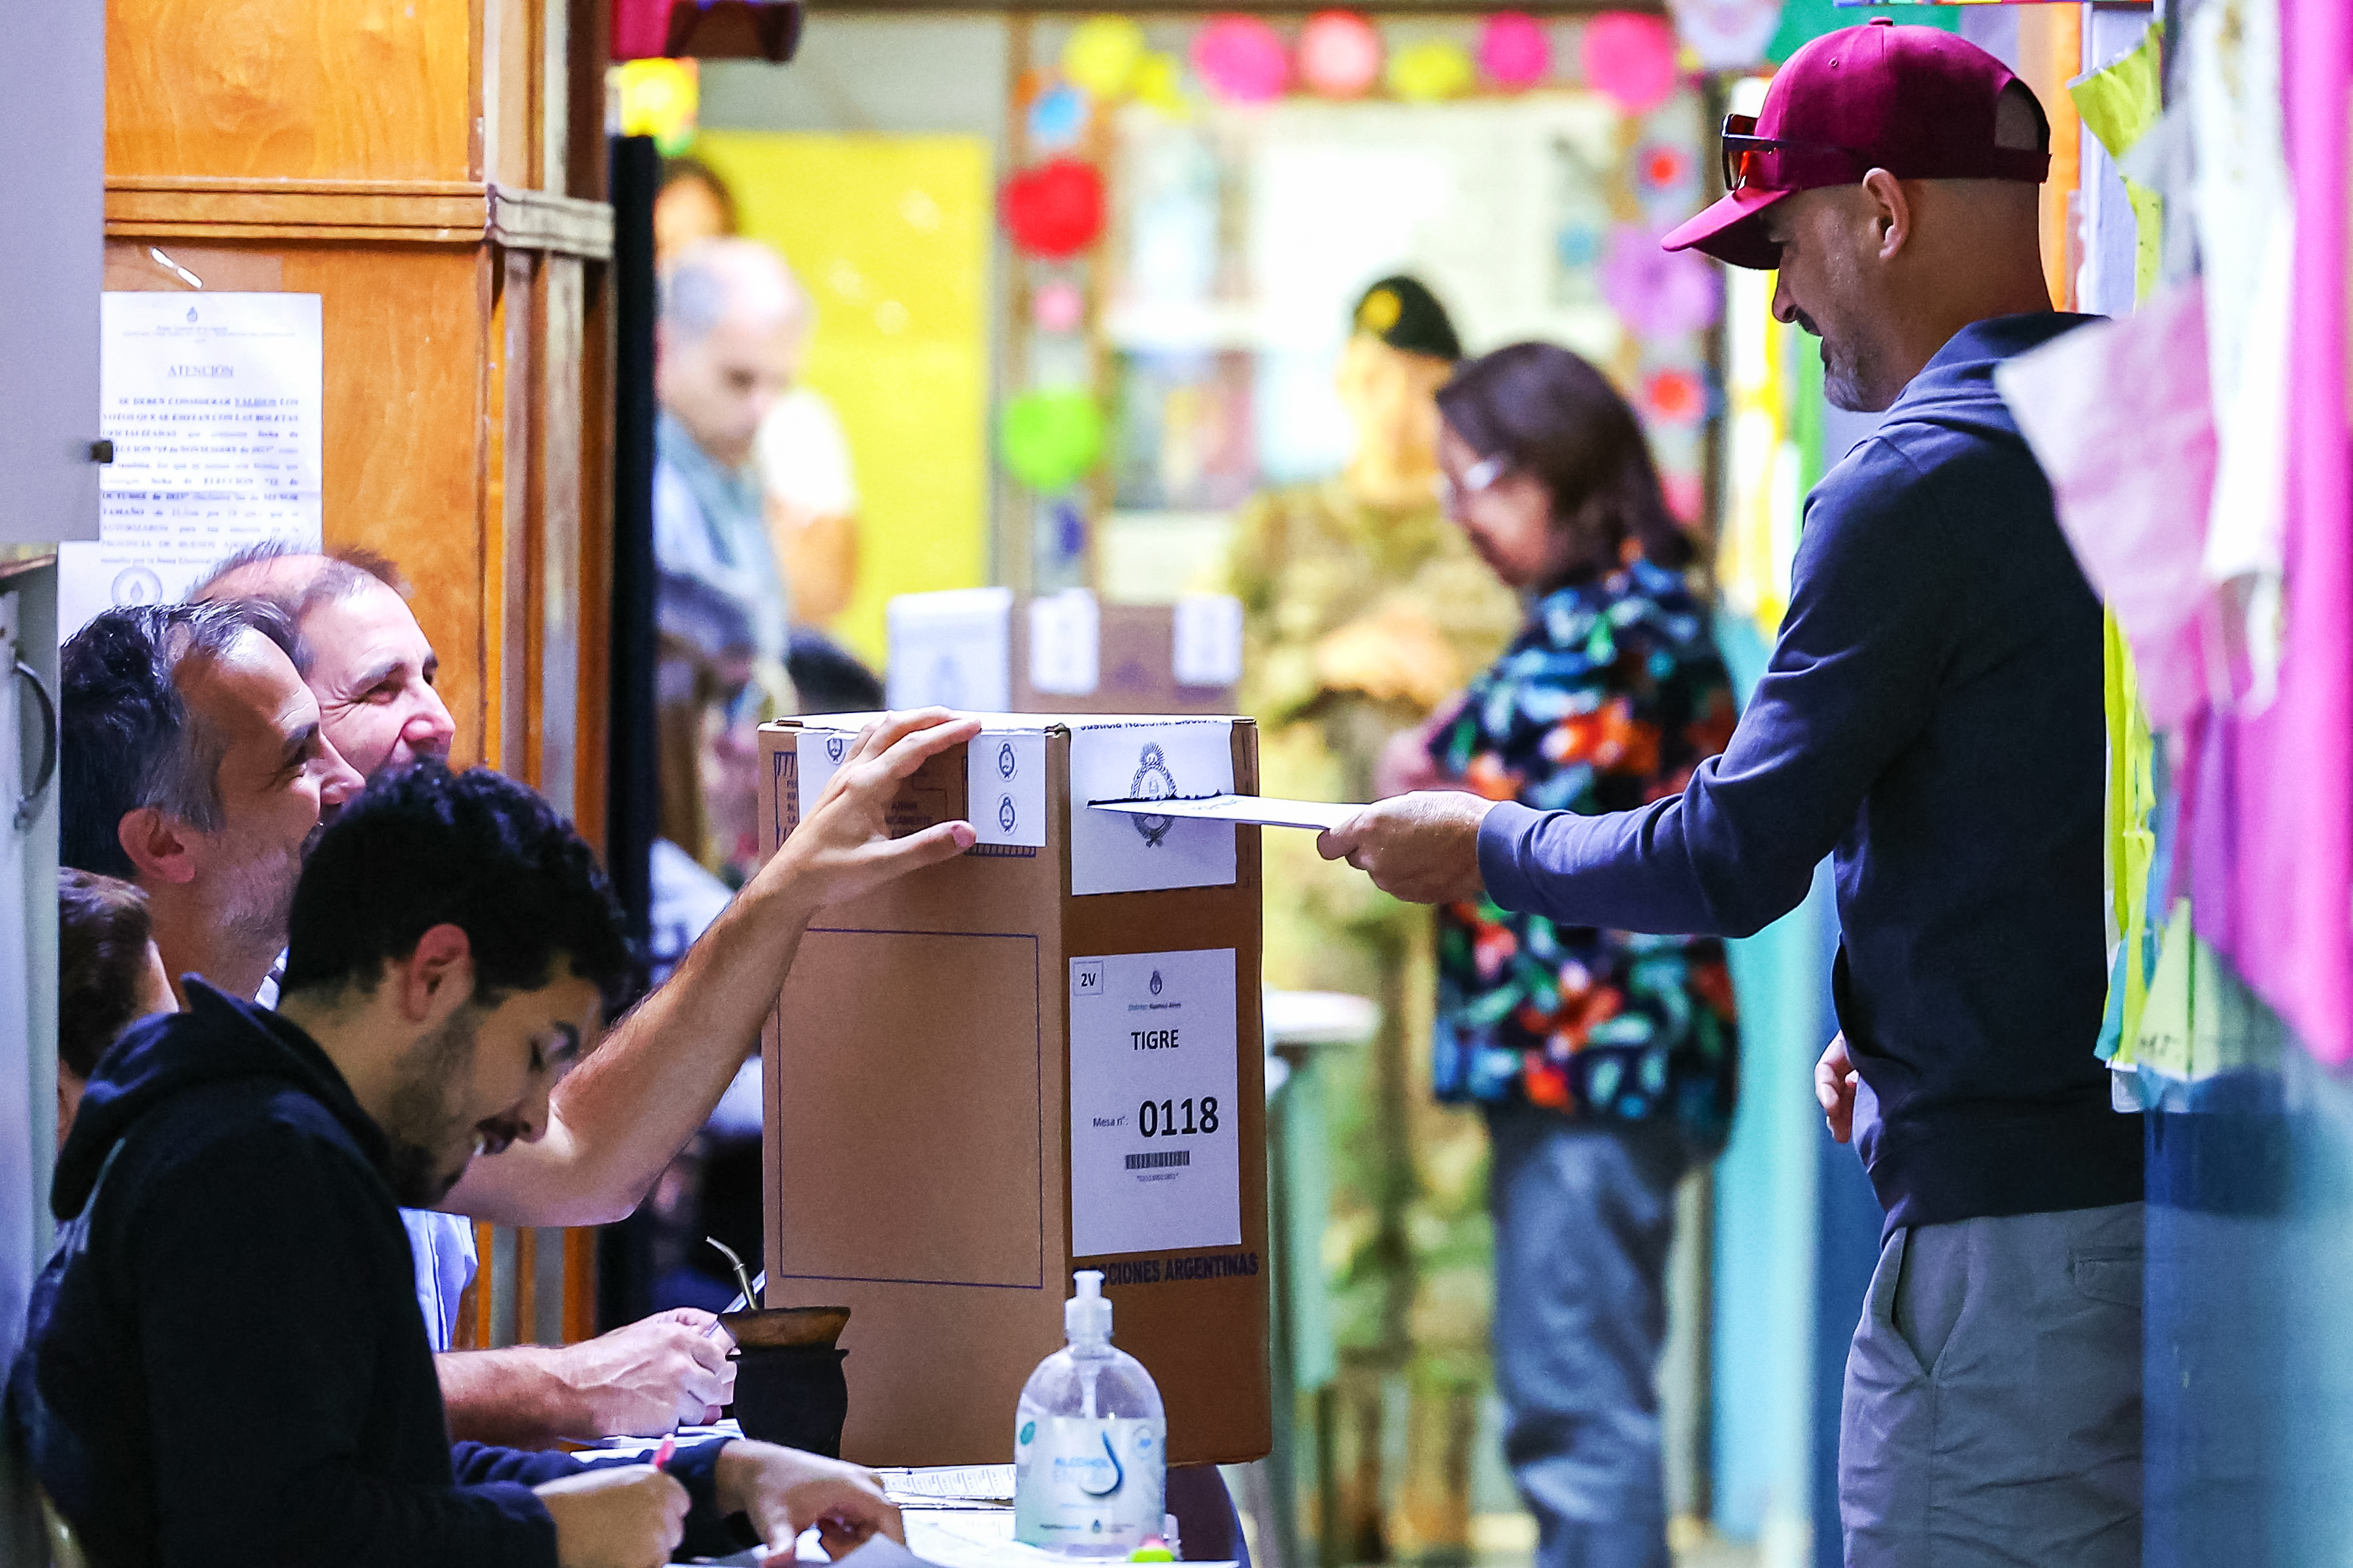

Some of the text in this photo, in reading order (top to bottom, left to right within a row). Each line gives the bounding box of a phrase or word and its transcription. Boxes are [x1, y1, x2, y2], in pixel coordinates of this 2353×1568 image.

[1081, 973, 1096, 988] 2V
[1130, 1029, 1179, 1050] TIGRE
[1093, 1117, 1115, 1127] Mesa
[1139, 1096, 1219, 1138] 0118
[1074, 1253, 1259, 1286] CIONES ARGENTINAS
